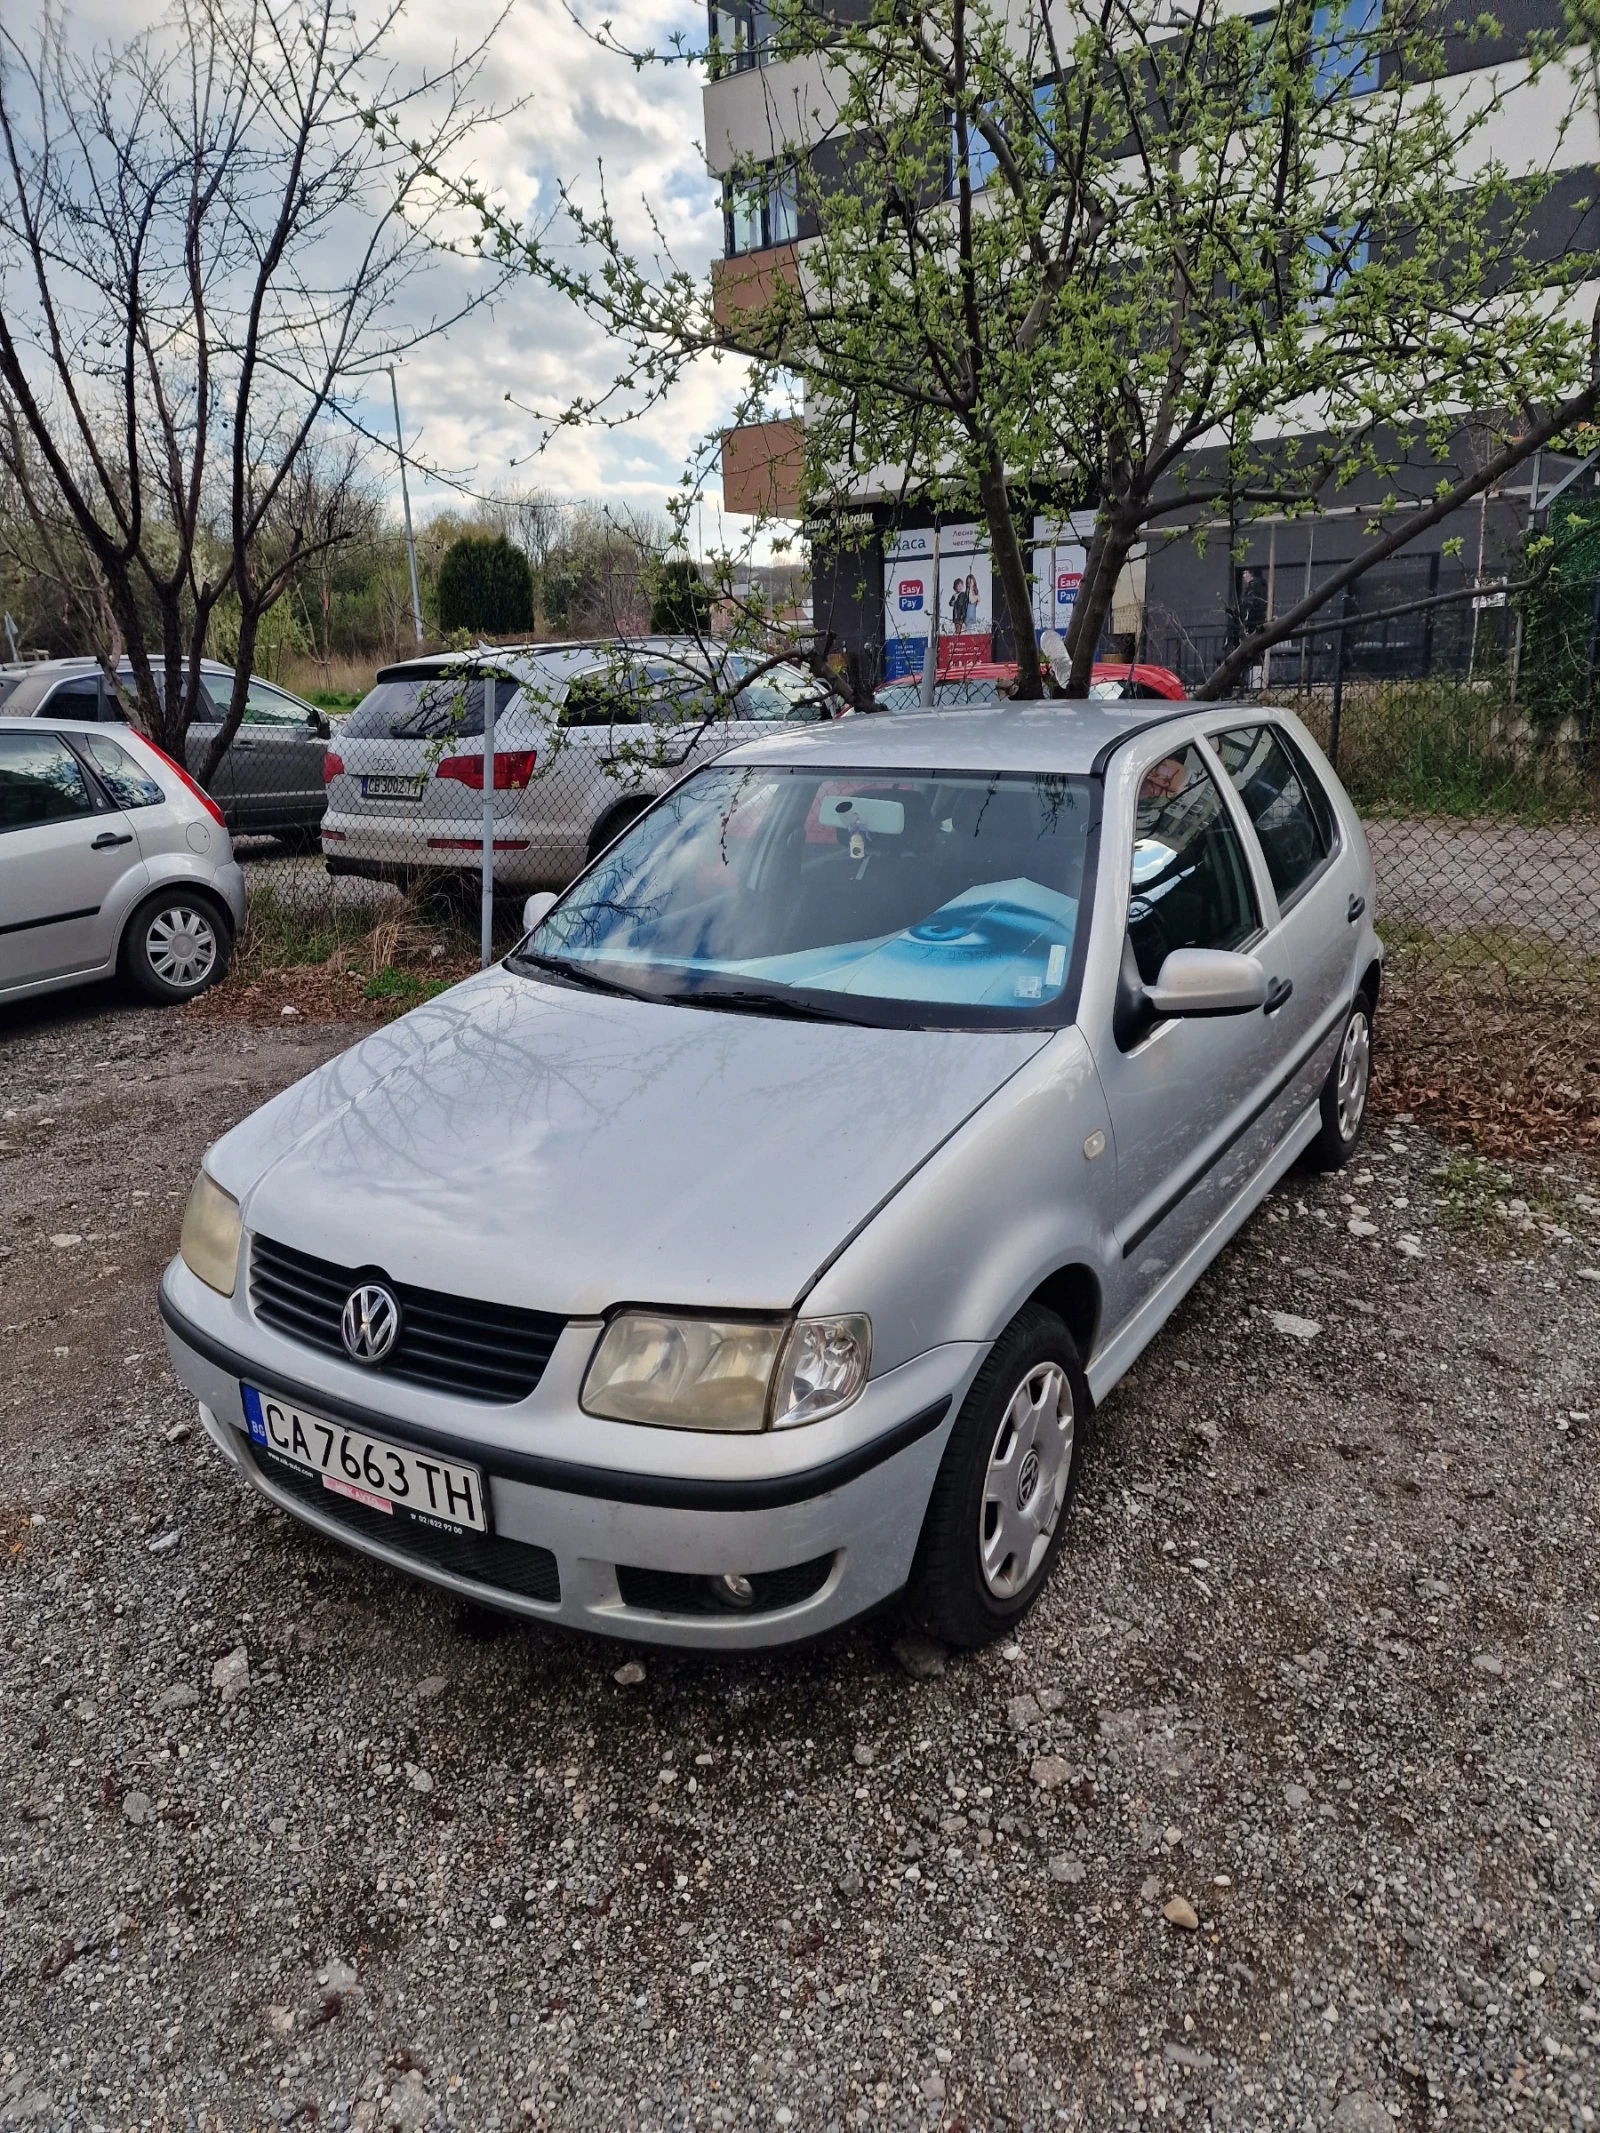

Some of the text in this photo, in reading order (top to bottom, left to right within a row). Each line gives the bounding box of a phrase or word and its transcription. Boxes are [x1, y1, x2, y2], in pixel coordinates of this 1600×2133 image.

[1060, 577, 1081, 588] Easy
[901, 584, 921, 595] Easy
[1060, 591, 1077, 602] Pay
[901, 599, 917, 609] Pay
[251, 1420, 265, 1437] BG
